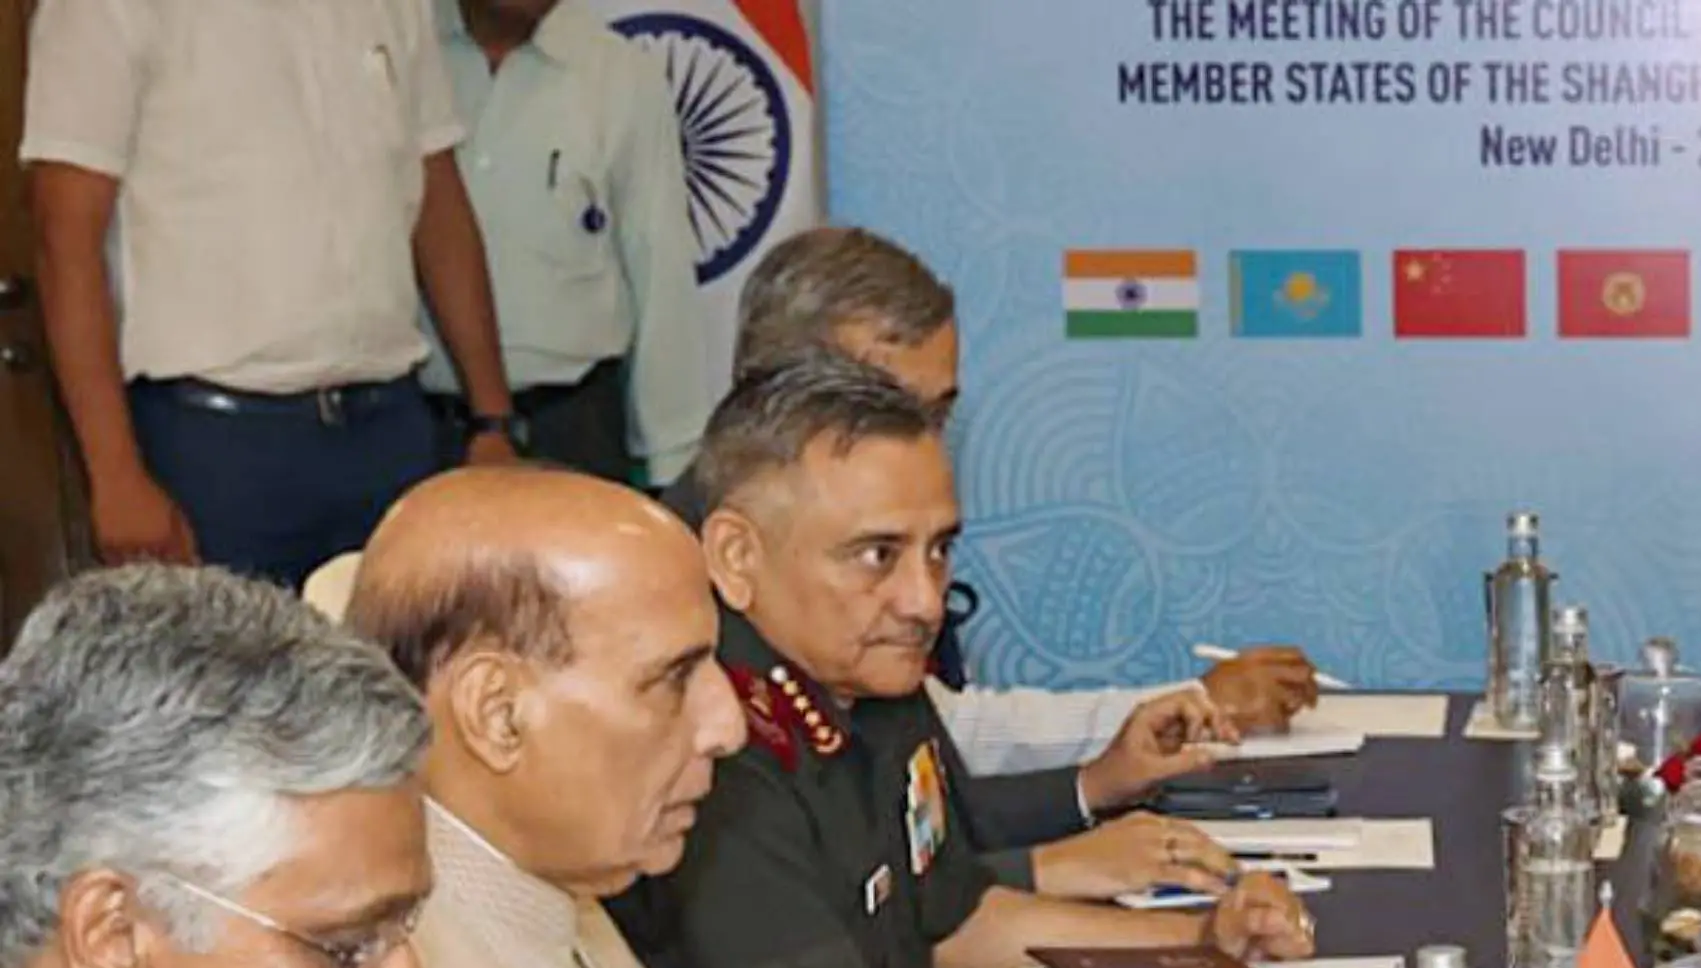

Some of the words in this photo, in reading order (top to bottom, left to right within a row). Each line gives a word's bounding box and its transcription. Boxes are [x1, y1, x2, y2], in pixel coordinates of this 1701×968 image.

[1148, 0, 1214, 39] THE
[1228, 0, 1385, 39] MEETING
[1398, 0, 1442, 39] OF
[1454, 0, 1521, 39] THE
[1532, 0, 1689, 39] COUNCIL
[1117, 61, 1273, 104] MEMBER
[1285, 61, 1416, 104] STATES
[1428, 61, 1472, 104] OF
[1483, 61, 1550, 104] THE
[1480, 124, 1558, 167] New
[1568, 124, 1660, 167] Delhi
